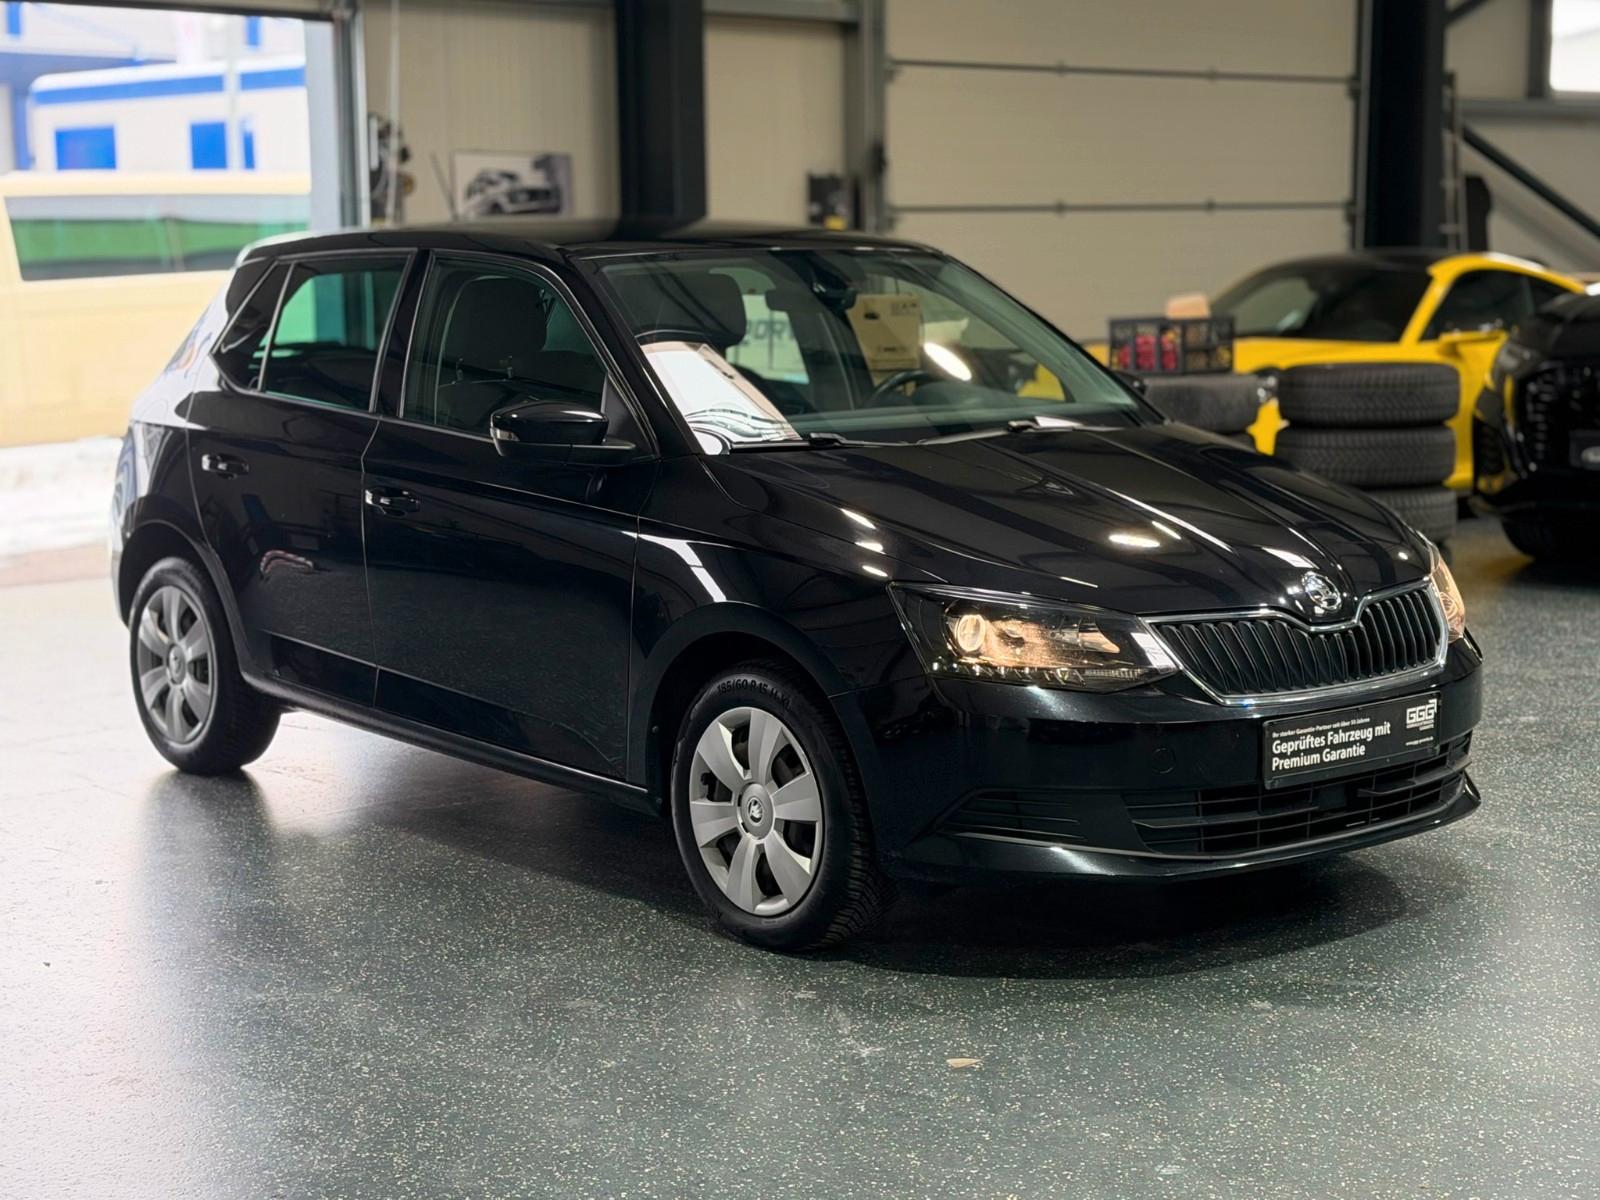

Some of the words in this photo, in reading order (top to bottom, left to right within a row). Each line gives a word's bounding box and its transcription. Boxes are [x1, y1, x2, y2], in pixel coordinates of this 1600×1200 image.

[717, 679, 748, 694] 185/60
[1405, 702, 1436, 723] GGG
[1272, 734, 1326, 755] Geprüftes
[1327, 728, 1373, 745] Fahrzeug
[1375, 721, 1391, 737] mit
[1272, 752, 1320, 771] Premium
[1322, 743, 1366, 762] Garantie
